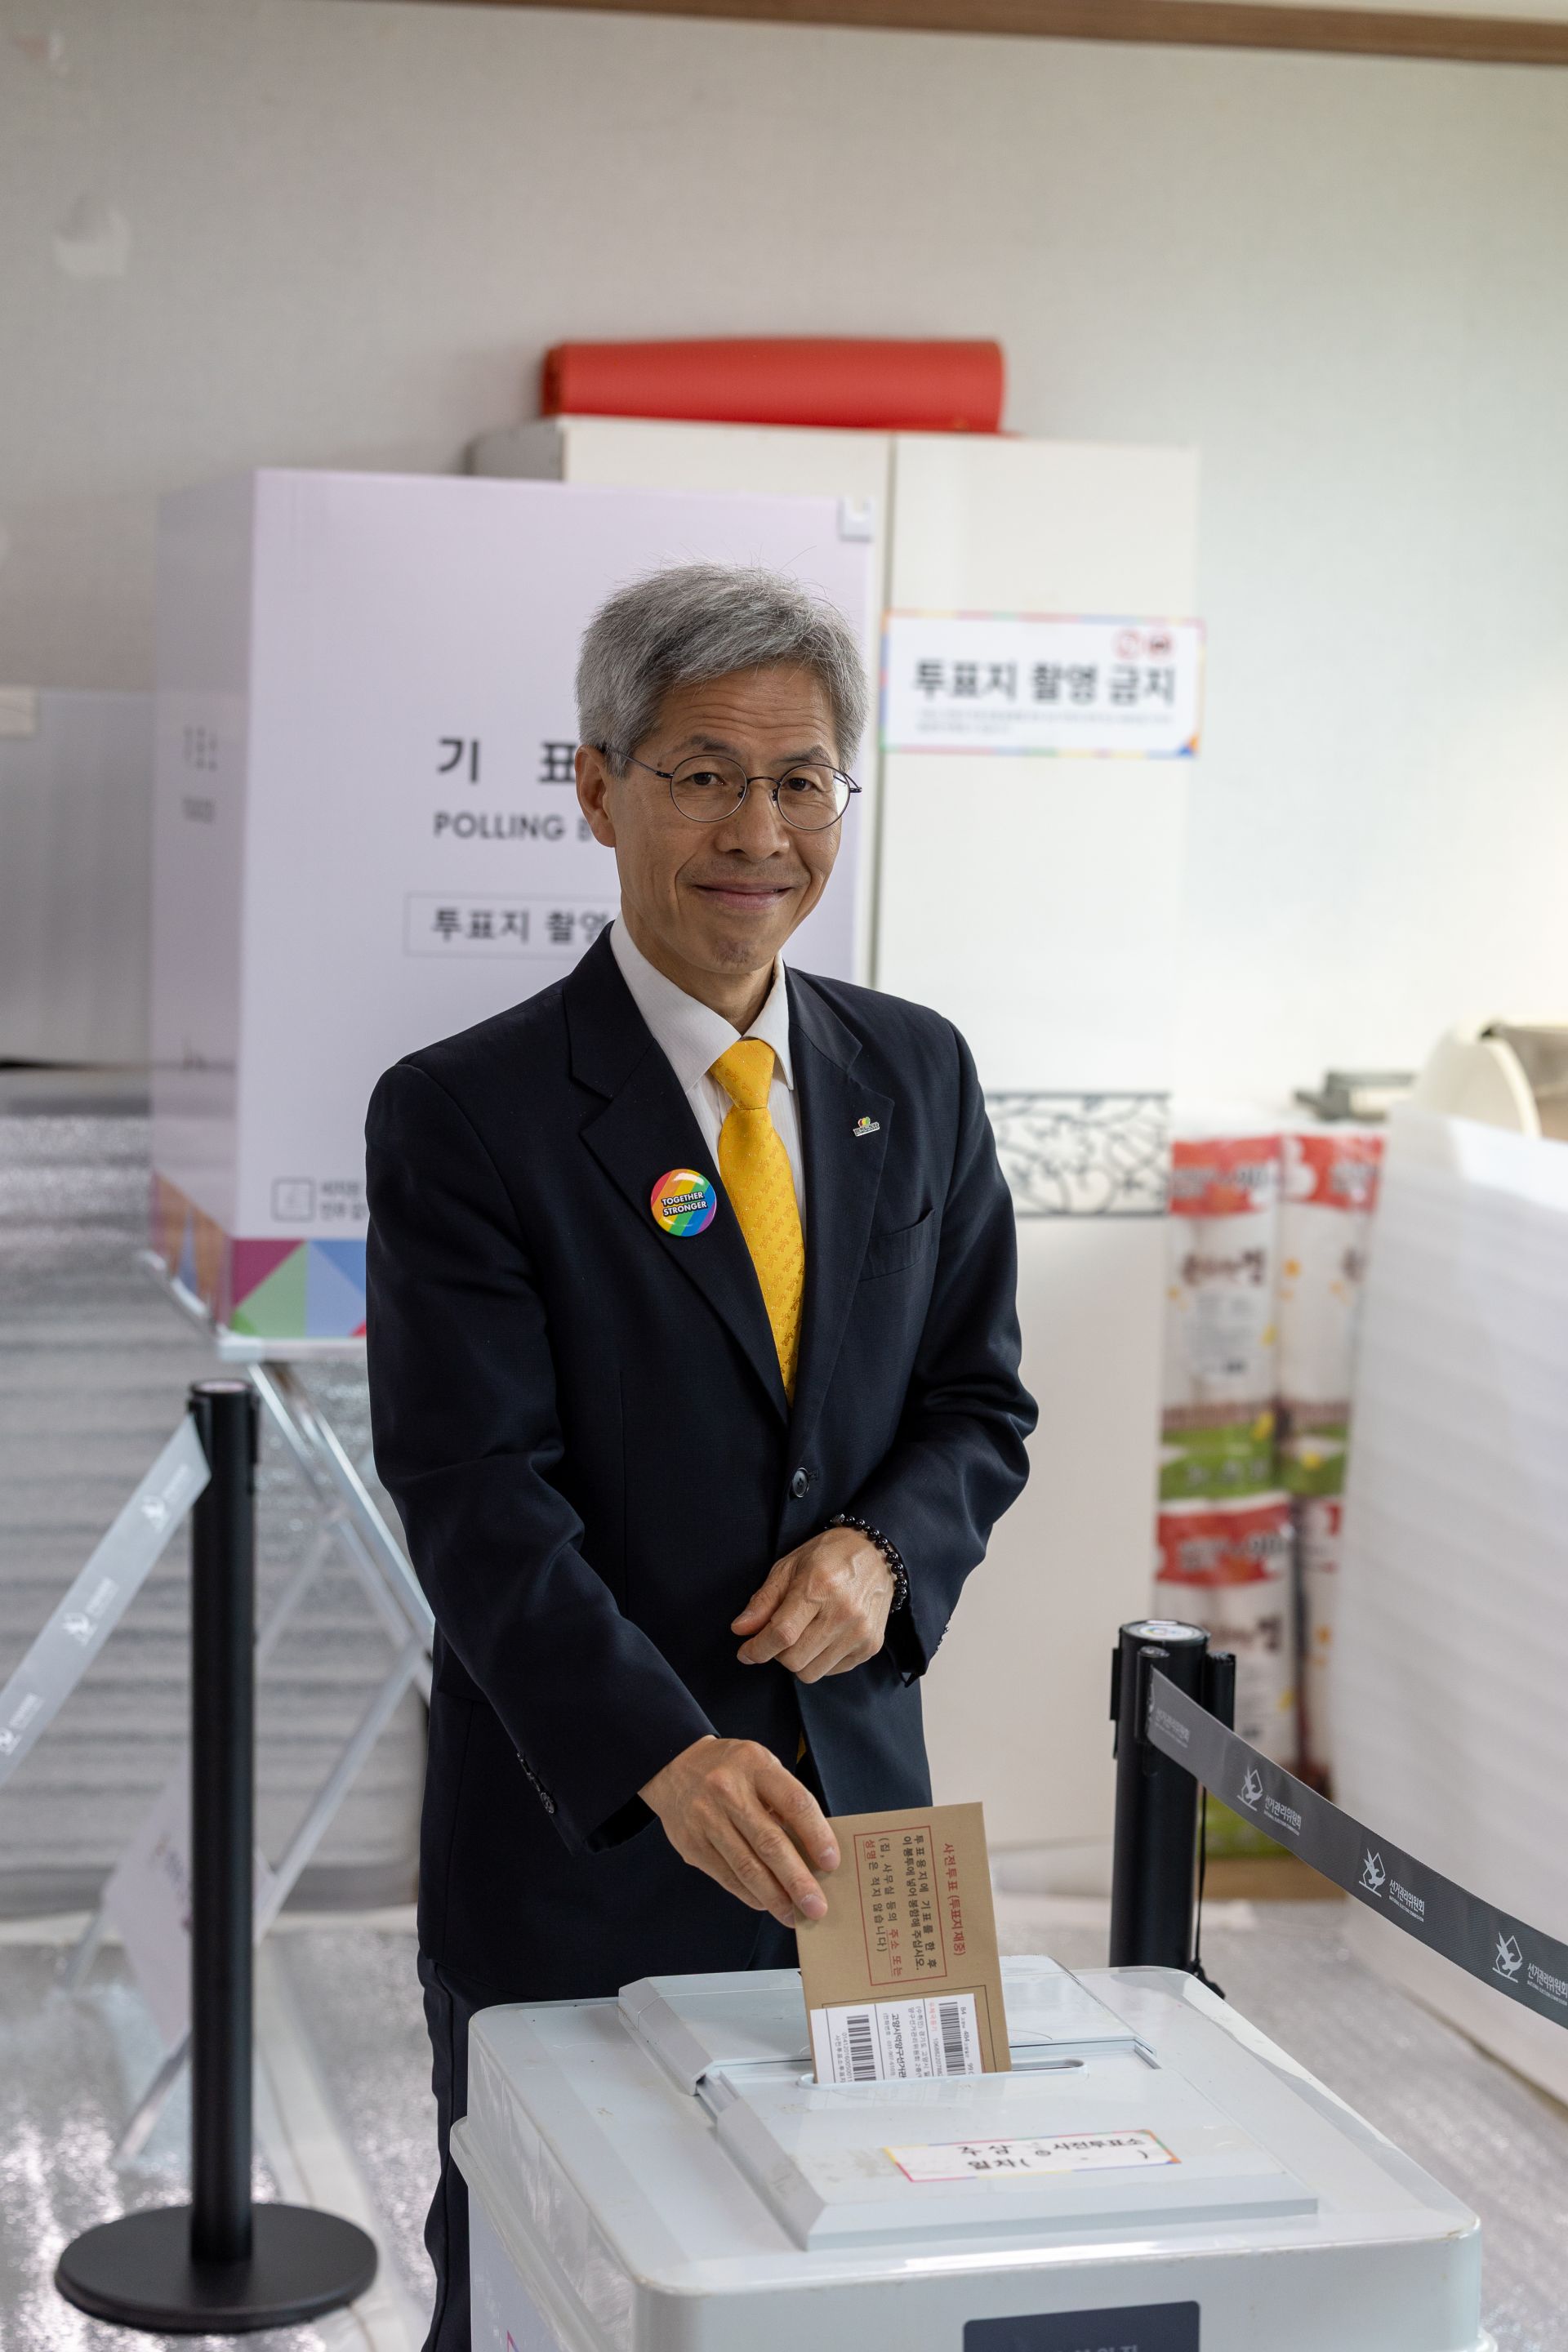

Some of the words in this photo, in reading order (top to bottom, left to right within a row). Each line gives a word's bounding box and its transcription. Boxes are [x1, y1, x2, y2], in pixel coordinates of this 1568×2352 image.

[915, 658, 1018, 702] 투표지
[1031, 662, 1098, 705] 촬영
[1109, 664, 1176, 706] 금지
[438, 737, 480, 785] 기
[433, 811, 565, 842] POLLING
[431, 906, 531, 945] 투표지
[662, 1192, 704, 1206] TOGETHER
[663, 1200, 707, 1216] STRONGER
[865, 1839, 877, 1870] 성명은
[878, 1837, 890, 1857] (집,
[902, 1836, 911, 1845] 이
[902, 1847, 915, 1875] 봉투에
[913, 1834, 929, 1892] 투표용지에
[942, 1842, 957, 1891] 사전투표
[869, 1876, 880, 1896] 적지
[881, 1863, 893, 1895] 사무실
[906, 1878, 916, 1895] 넣어
[885, 1900, 897, 1921] 등의
[947, 1895, 962, 1929] (투표지
[1389, 1879, 1425, 1916] 선거관리위원회
[871, 1903, 886, 1952] 않습니다)
[908, 1899, 920, 1927] 봉함해
[920, 1900, 933, 1933] 기표를
[889, 1928, 899, 1949] 주소
[911, 1929, 924, 1970] 주십시오.
[924, 1941, 934, 1950] 한
[891, 1955, 902, 1976] 또는
[926, 1958, 936, 1968] 후
[1527, 1962, 1568, 1999] 선거관리위원회
[1053, 2136, 1146, 2151] 사전투표소
